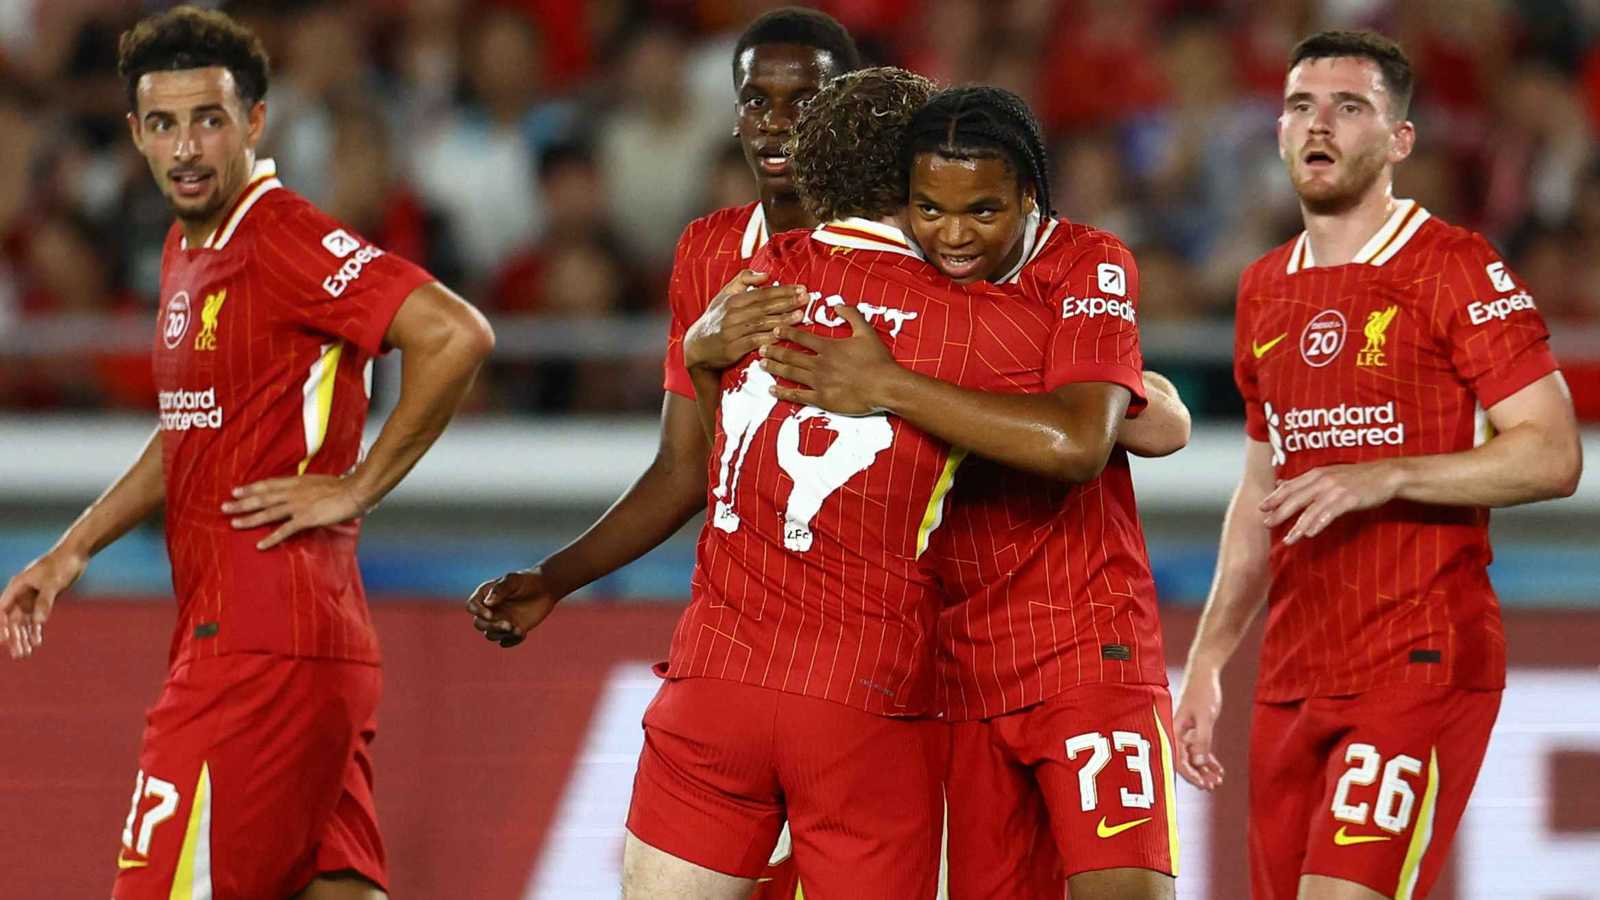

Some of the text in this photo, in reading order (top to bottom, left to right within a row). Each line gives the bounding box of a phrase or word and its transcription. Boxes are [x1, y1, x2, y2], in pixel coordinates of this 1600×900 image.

[322, 245, 386, 298] Exped
[166, 312, 186, 337] 20
[1306, 330, 1338, 356] 20
[1284, 401, 1394, 431] standard
[1285, 422, 1404, 452] chartered
[1064, 730, 1155, 812] 73
[1330, 743, 1423, 834] 26
[122, 768, 180, 856] 17
